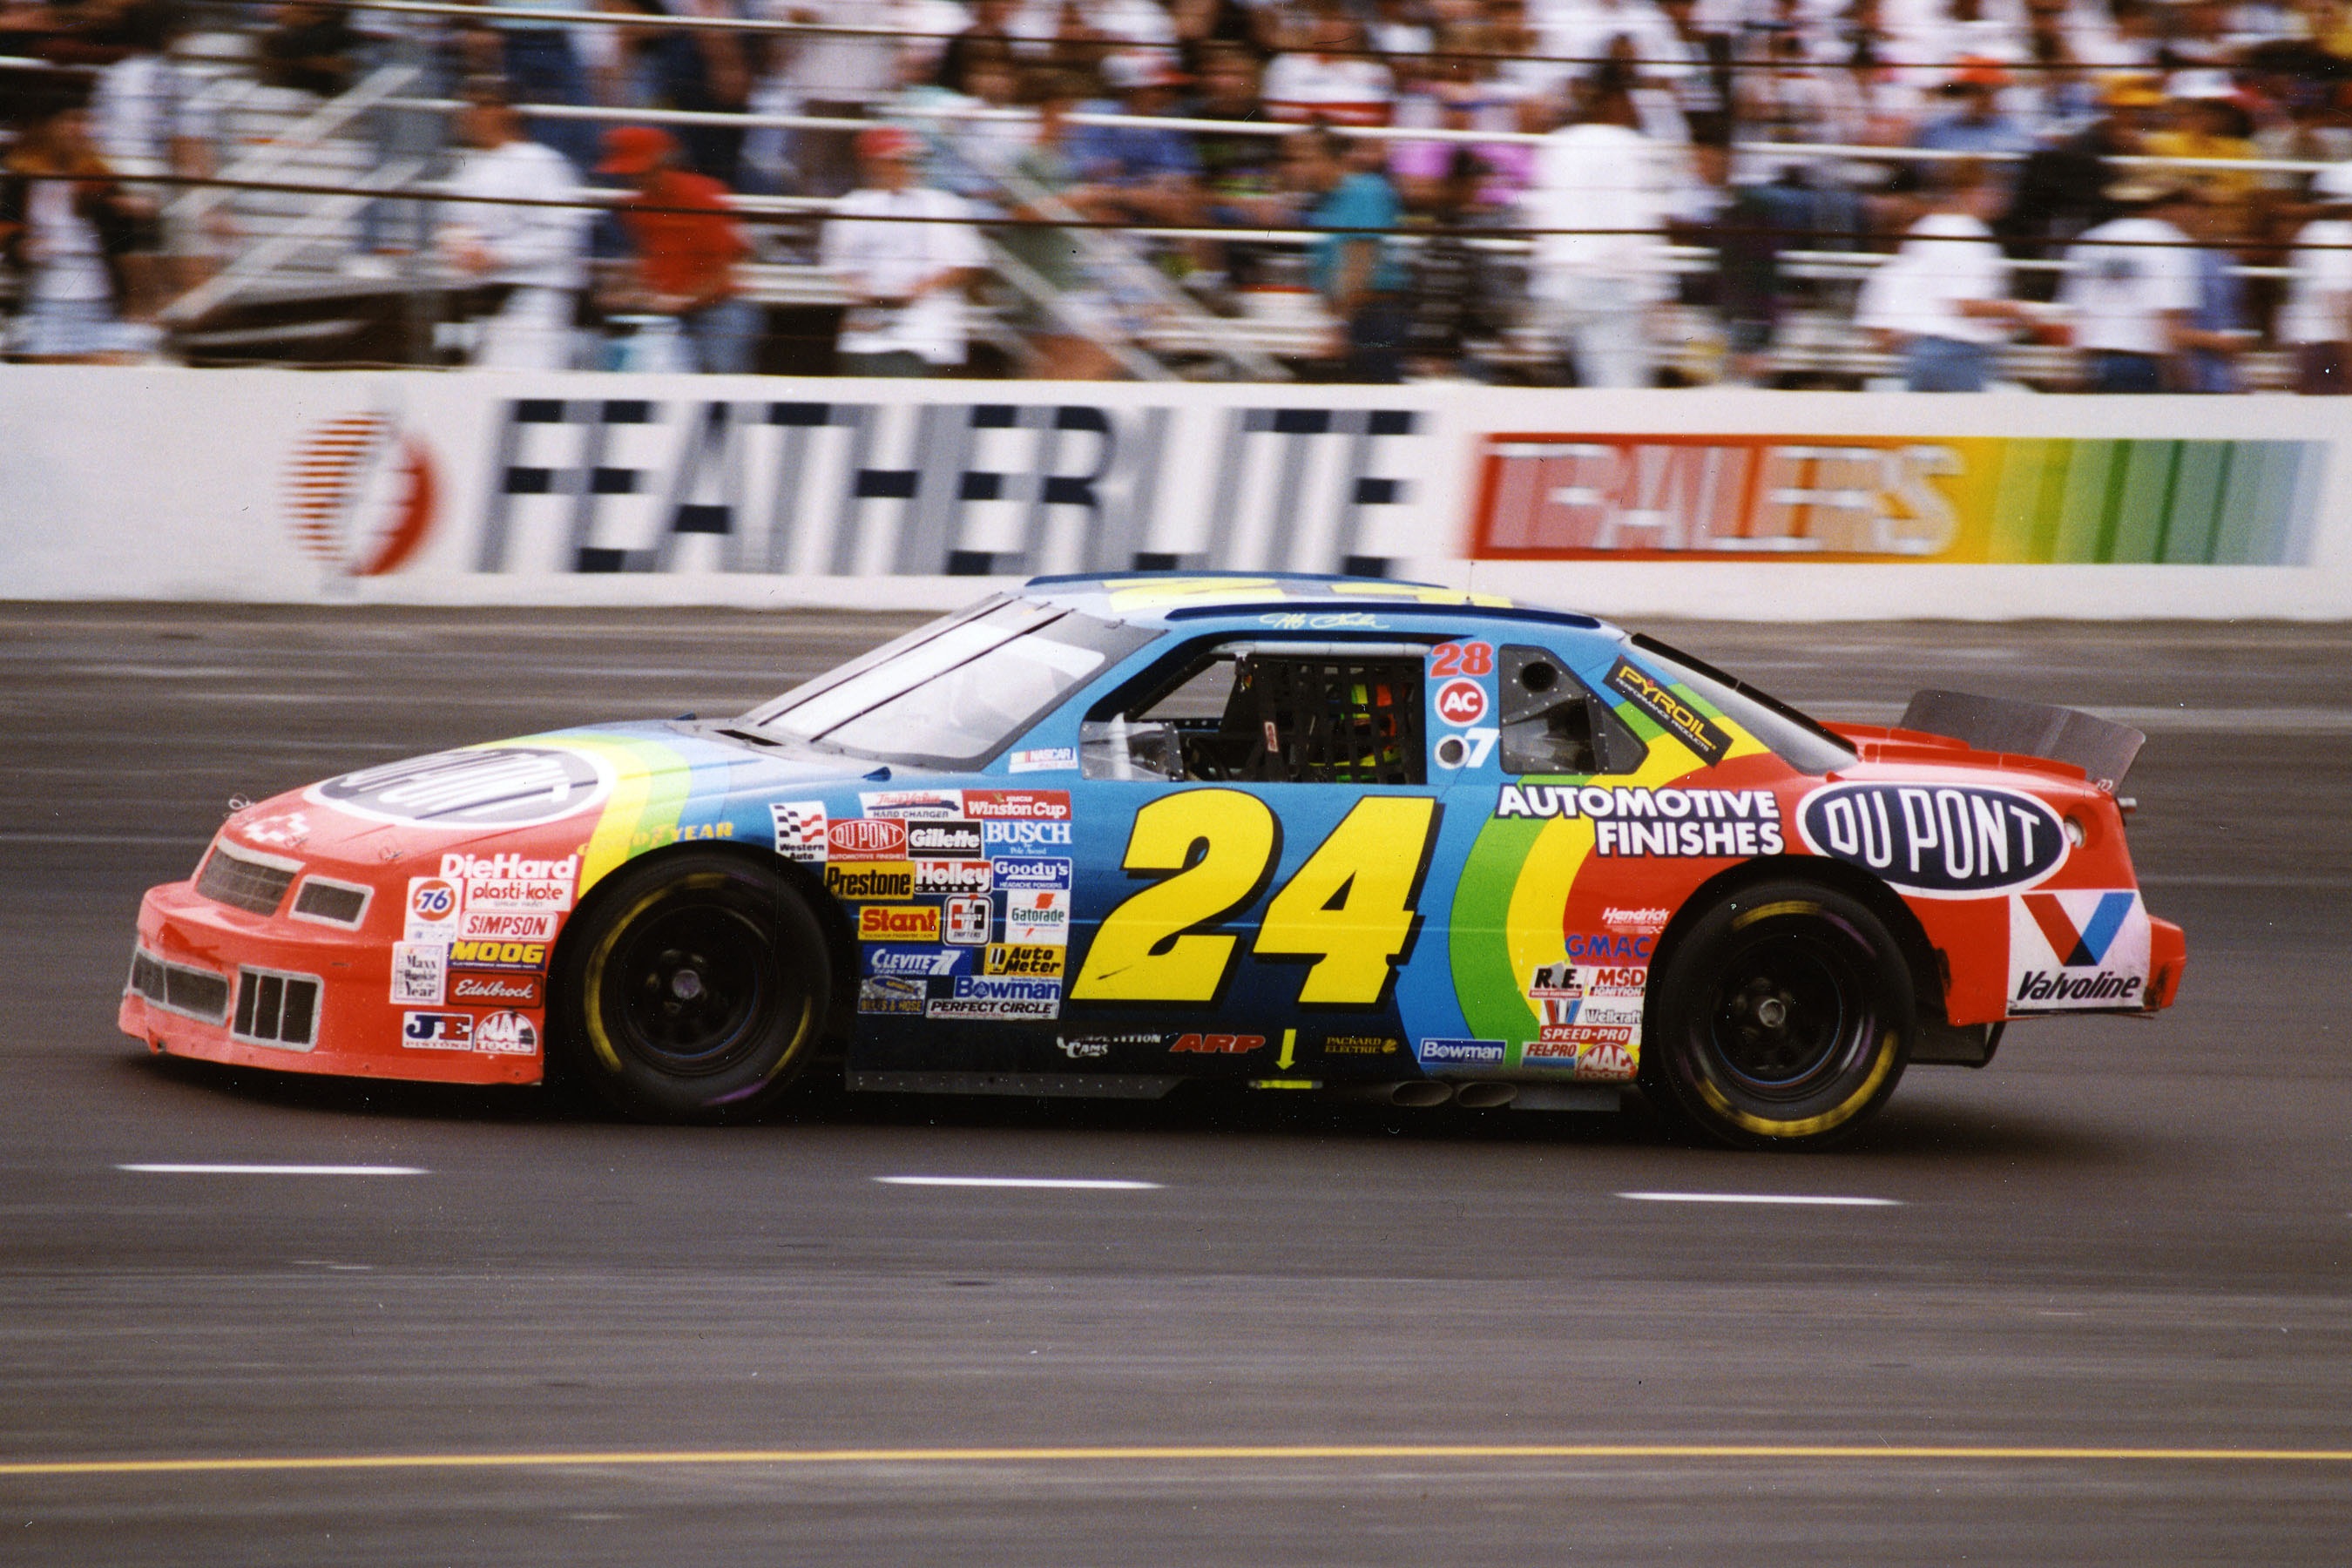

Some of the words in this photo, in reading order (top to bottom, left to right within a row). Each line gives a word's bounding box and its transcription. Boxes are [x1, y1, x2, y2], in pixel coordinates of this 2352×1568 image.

[1430, 641, 1493, 678] 28
[1443, 691, 1478, 713] AC
[1619, 666, 1713, 747] PYROIL
[1616, 678, 1670, 720] PERFORMANCE
[1671, 720, 1710, 752] PRODUCTS
[968, 801, 1032, 815] Winston
[1033, 801, 1067, 819] Cup
[1497, 786, 1780, 819] AUTOMOTIVE
[858, 822, 899, 848] PONT
[909, 828, 980, 848] Gillette
[985, 821, 1072, 844] BUSCH
[1597, 821, 1784, 855] FINISHES
[1824, 791, 1893, 868] DU
[1898, 788, 2040, 879] PONT
[440, 853, 578, 879] DieHard
[995, 861, 1069, 881] Goody's
[828, 867, 910, 896] Prestone
[916, 862, 990, 892] Holley
[421, 890, 448, 910] 76
[473, 882, 564, 900] plasti-kote
[1069, 787, 1439, 1004] 24
[467, 915, 549, 936] SIMPSON
[862, 909, 937, 932] Stant
[1011, 907, 1064, 923] Gatorade
[1602, 907, 1671, 924] Hendrick
[449, 941, 546, 963] MOOG
[1009, 947, 1053, 960] Auto
[1565, 934, 1652, 957] GMAC
[872, 949, 931, 970] CLEVITE
[1006, 959, 1061, 974] Meter
[956, 977, 1060, 999] Bowman
[1595, 969, 1646, 987] MSD
[2016, 971, 2141, 1001] Valvoline
[405, 981, 436, 997] Year
[455, 979, 533, 999] Edelbrock
[1595, 987, 1642, 997] IGNITION
[930, 1002, 998, 1012] PERFECT
[1000, 1003, 1052, 1014] CIRCLE
[1585, 1009, 1642, 1024] Wellcraft
[406, 1014, 470, 1042] JE
[1541, 1028, 1630, 1041] SPEED-PRO
[479, 1041, 533, 1054] TOOLS
[1169, 1034, 1266, 1053] ARP
[1327, 1037, 1382, 1045] PACKARD
[1423, 1041, 1504, 1059] Bowman
[1525, 1043, 1578, 1058] FEL-PRO
[1580, 1044, 1632, 1071] MAC
